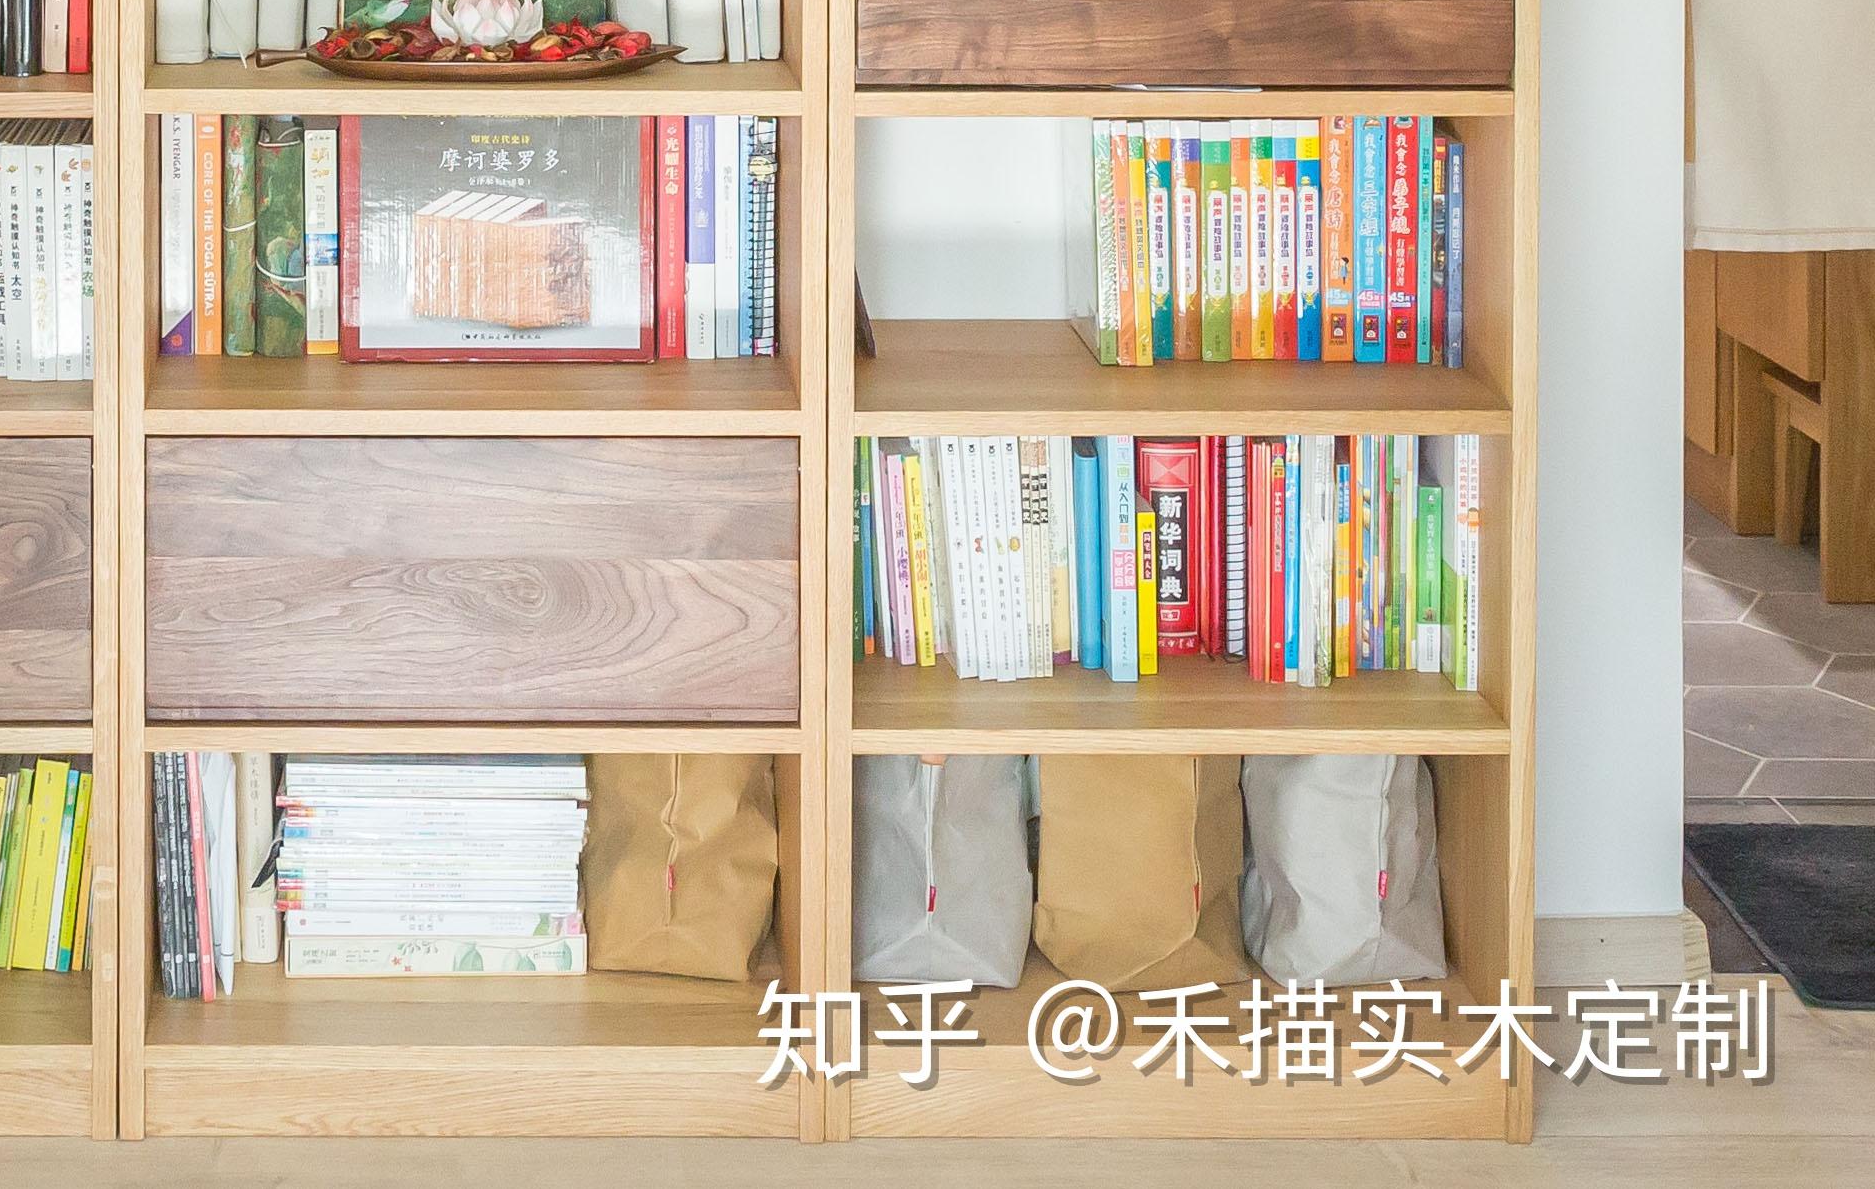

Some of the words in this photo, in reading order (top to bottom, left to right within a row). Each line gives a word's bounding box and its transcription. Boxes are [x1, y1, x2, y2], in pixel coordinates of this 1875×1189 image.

[204, 152, 215, 186] CORE
[439, 148, 560, 173] 摩诃婆罗多
[204, 210, 215, 232] THE
[204, 234, 215, 269] YOGA
[10, 274, 22, 301] 太空
[1158, 495, 1183, 599] 新华词典
